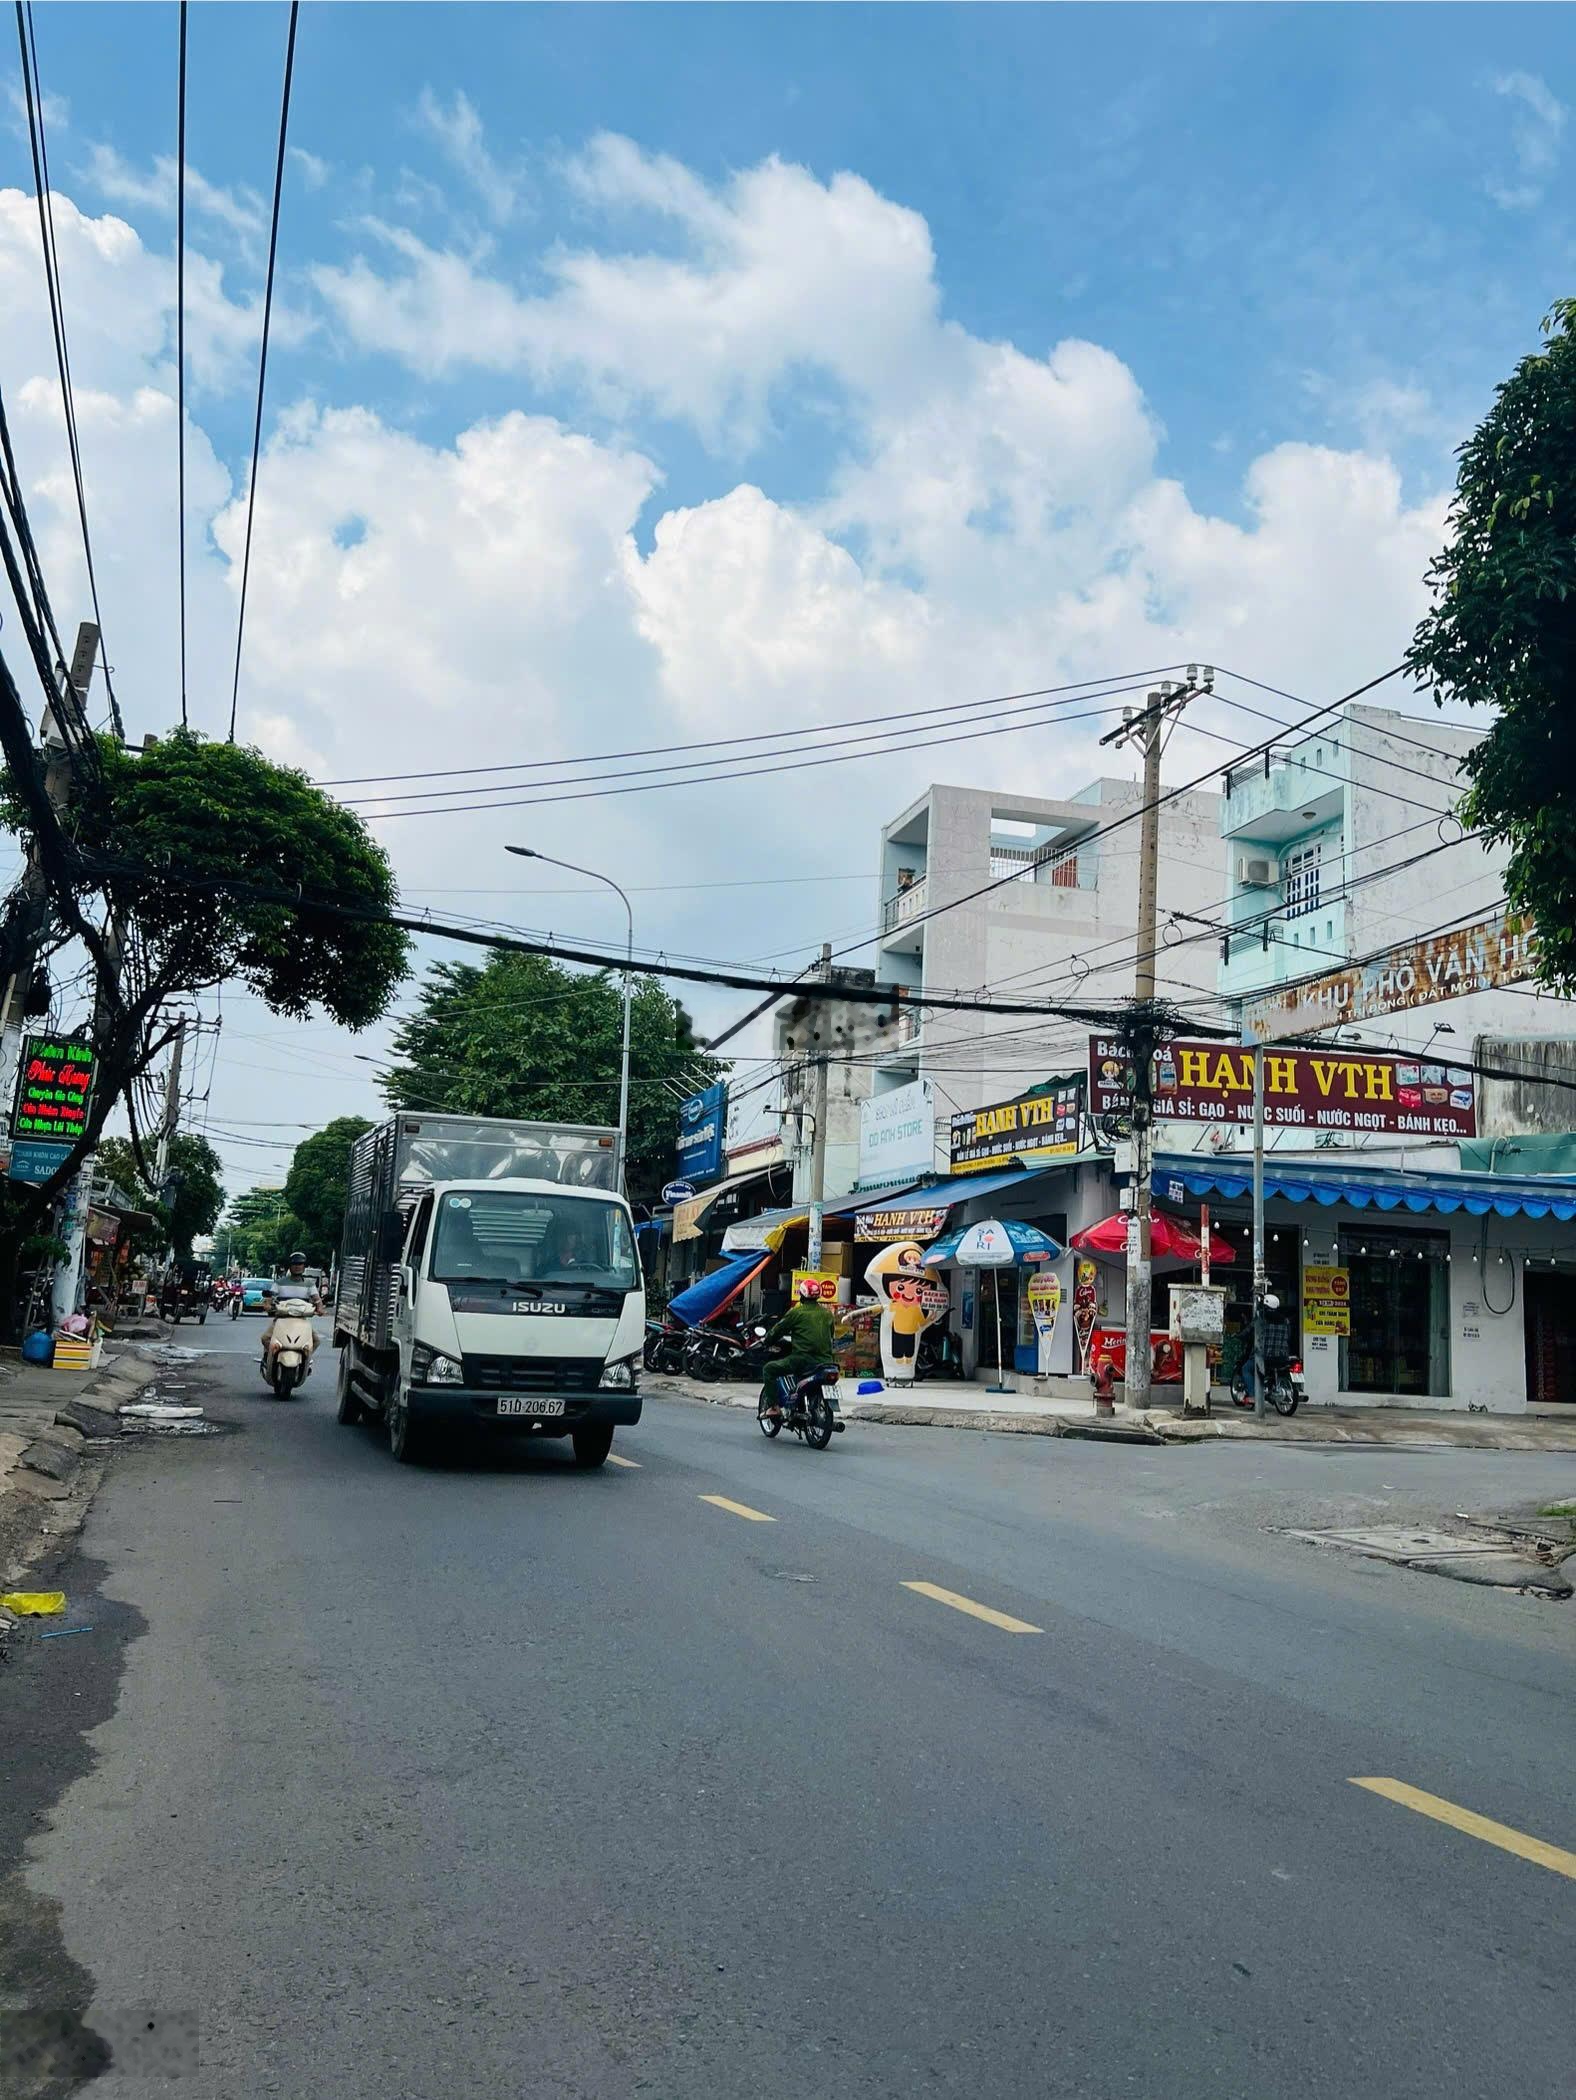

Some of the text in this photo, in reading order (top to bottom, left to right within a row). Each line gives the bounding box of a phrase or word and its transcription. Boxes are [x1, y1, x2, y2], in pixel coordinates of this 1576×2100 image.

[1303, 982, 1349, 1010] KHU
[1362, 959, 1415, 1001] PHỐ
[1425, 943, 1484, 983] VĂN
[1179, 1050, 1394, 1101] HẠNH VTH
[975, 1105, 1018, 1140] HẠNH
[1020, 1096, 1054, 1128] VTH
[1153, 1098, 1175, 1115] GIÁ
[1178, 1096, 1196, 1116] SỈ:
[1199, 1101, 1225, 1120] GẠO
[1276, 1103, 1305, 1123] SUỐI
[1317, 1107, 1351, 1126] NƯỚC
[1354, 1113, 1386, 1131] NGỌT
[1397, 1113, 1431, 1132] BÁNH
[897, 1119, 923, 1140] STORE
[909, 1209, 936, 1225] VTH
[512, 1301, 566, 1313] ISUZU
[500, 1398, 563, 1415] 51D-206.67
